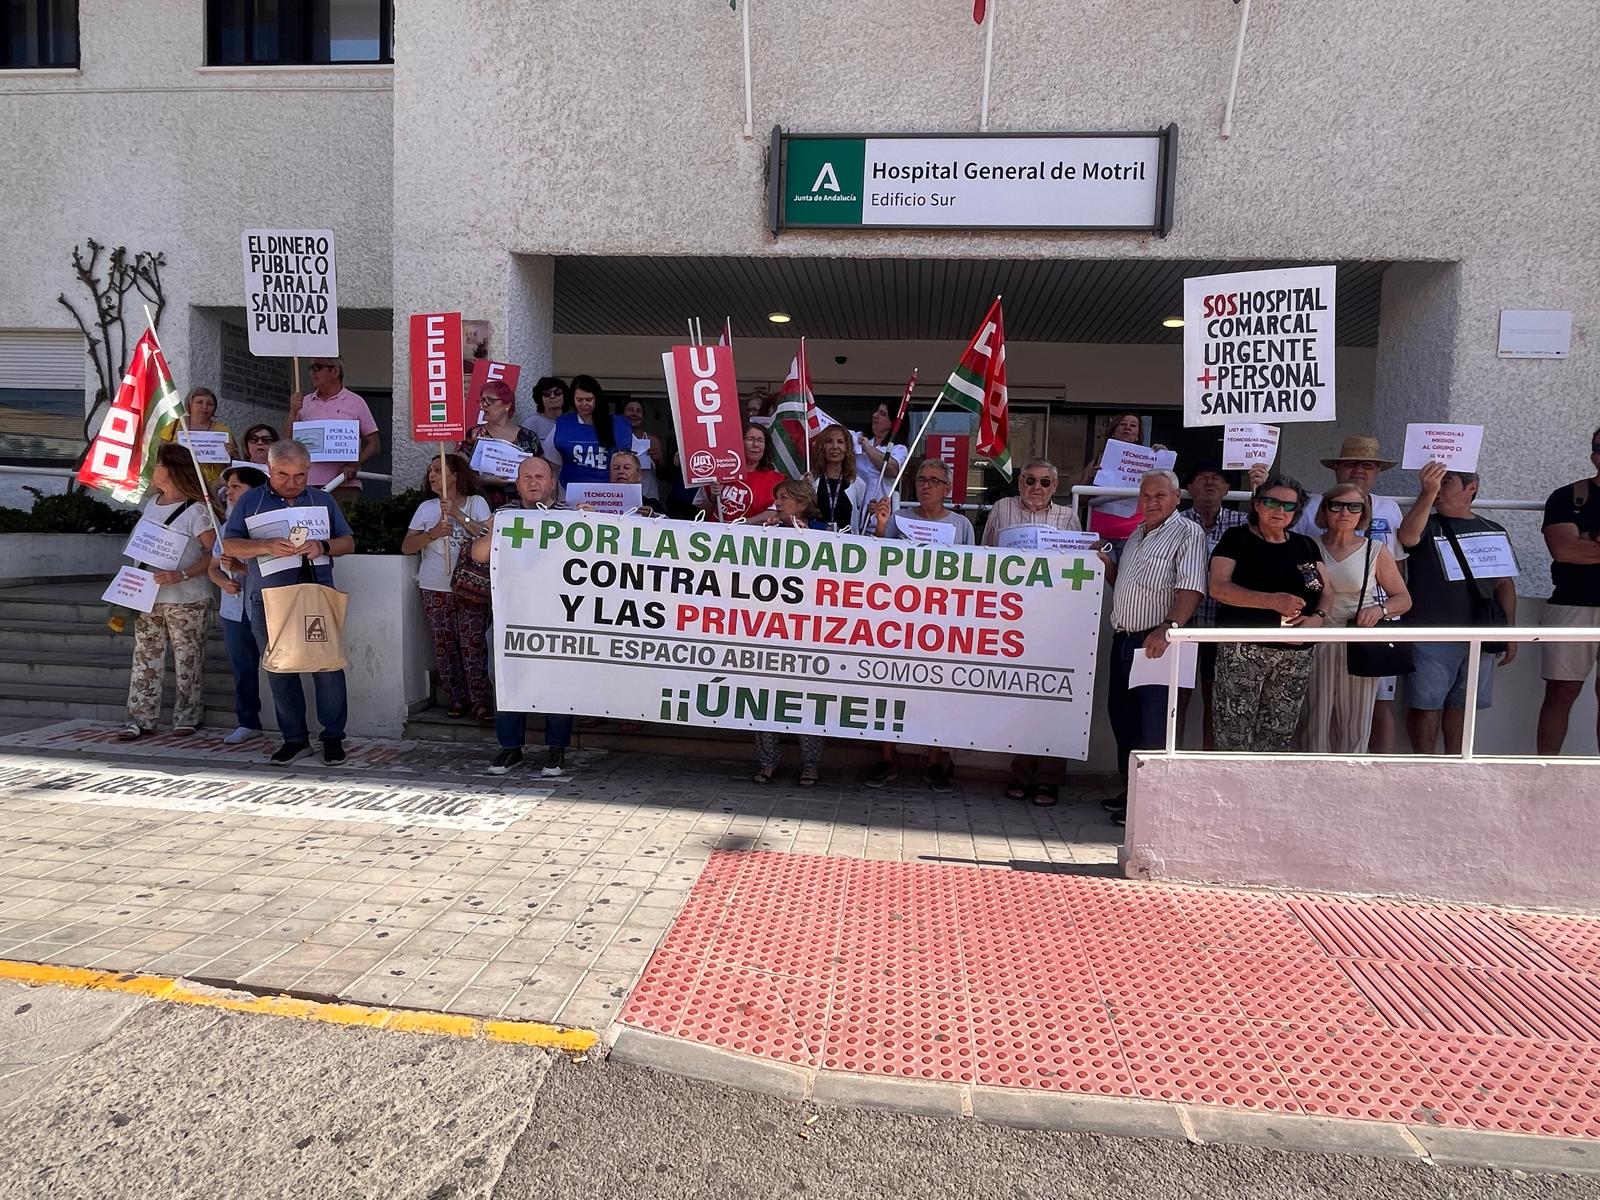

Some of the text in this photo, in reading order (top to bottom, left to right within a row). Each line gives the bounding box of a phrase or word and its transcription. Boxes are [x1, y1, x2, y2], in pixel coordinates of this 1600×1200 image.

[872, 162, 1146, 183] Hospital General de Motril
[794, 194, 812, 202] Junta
[823, 194, 857, 202] Andalucía
[871, 193, 956, 206] Edificio Sur
[248, 236, 328, 255] EL DINERO
[252, 255, 328, 275] PUBLICO
[263, 275, 329, 294] PARA LA
[252, 293, 328, 314] SANIDAD
[1203, 288, 1327, 318] SOS HOSPITAL
[256, 313, 328, 334] PUBLICA
[1207, 314, 1317, 338] COMARCAL
[427, 316, 446, 402] CCOO
[1204, 338, 1316, 365] URGENTE
[690, 347, 722, 448] UGT
[1200, 390, 1316, 415] SANITARIO
[694, 456, 711, 466] UGT
[539, 519, 1053, 588] POR LA SANIDAD PÚBLICA
[562, 558, 1024, 621] CONTRA LOS RECORTES
[560, 594, 1024, 658] Y LAS PRIVATIZACIONES
[504, 632, 1073, 695] MOTRIL ESPACIO ABIERTO SOMOS COMARCA
[660, 677, 906, 732] ¡¡ÚNETE!!
